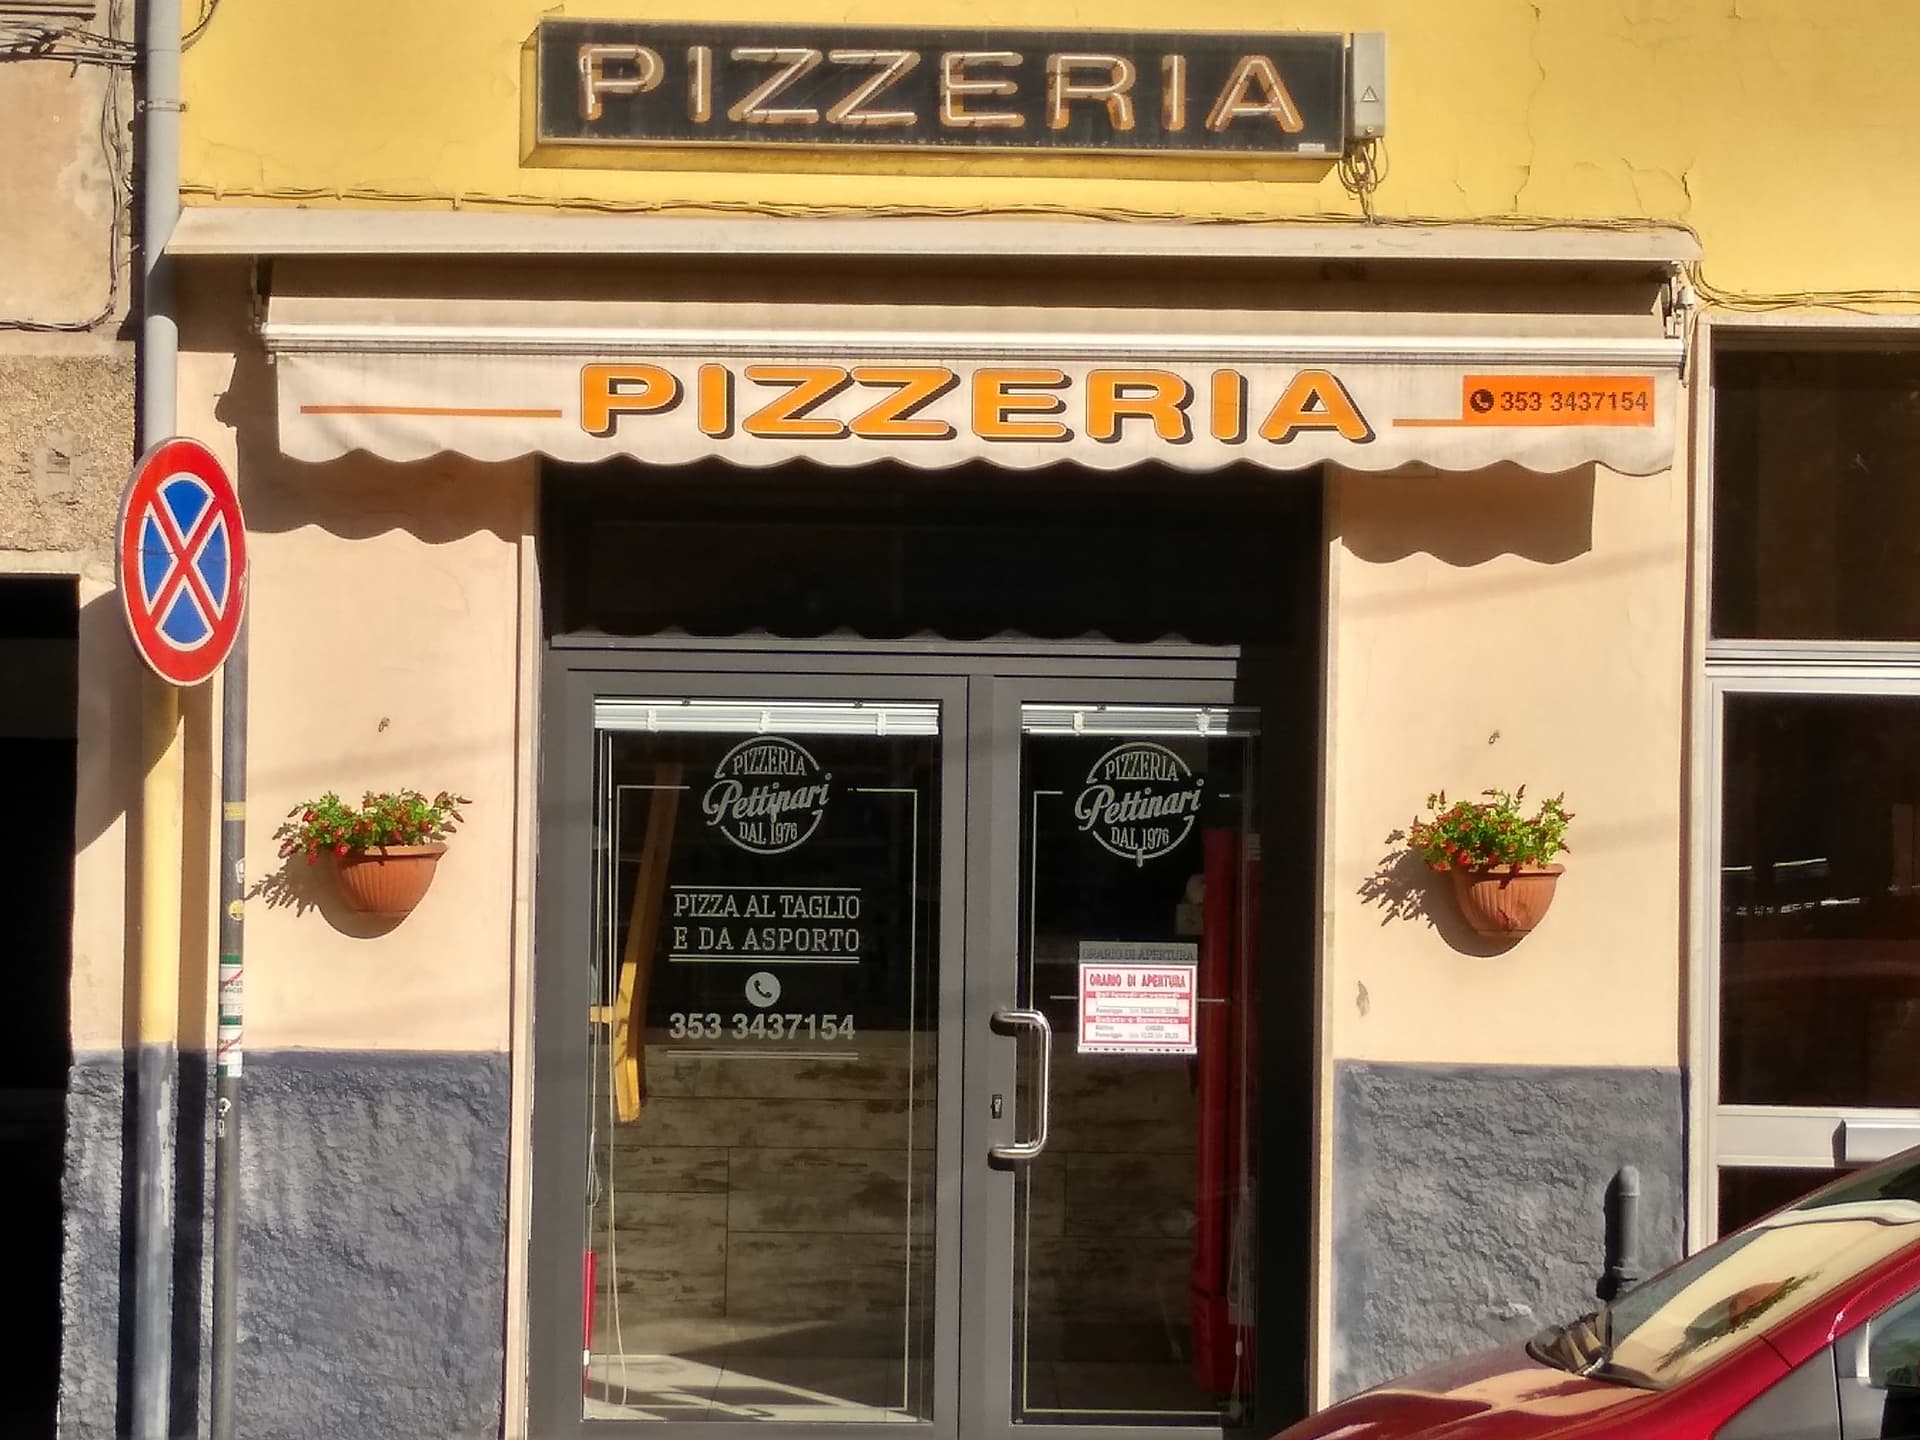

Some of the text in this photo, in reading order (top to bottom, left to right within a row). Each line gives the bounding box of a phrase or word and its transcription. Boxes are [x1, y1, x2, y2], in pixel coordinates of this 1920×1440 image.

[578, 43, 1304, 133] PIZZERIA
[580, 362, 1377, 443] PIZZERIA
[1500, 390, 1649, 412] 353 3437154
[731, 745, 808, 776] PIZZERIA
[1104, 751, 1180, 782] PIZZERIA
[702, 771, 833, 826] Pettinari
[1074, 777, 1205, 831] Pettinari
[738, 821, 798, 845] DAL 1976
[1110, 826, 1169, 850] DAL 1976
[673, 893, 861, 919] PIZZA AL TAGLIO
[673, 926, 860, 952] E DA ASPORTO
[1089, 973, 1187, 989] ORARIO DI APERTURA
[669, 1012, 856, 1041] 353 3437154
